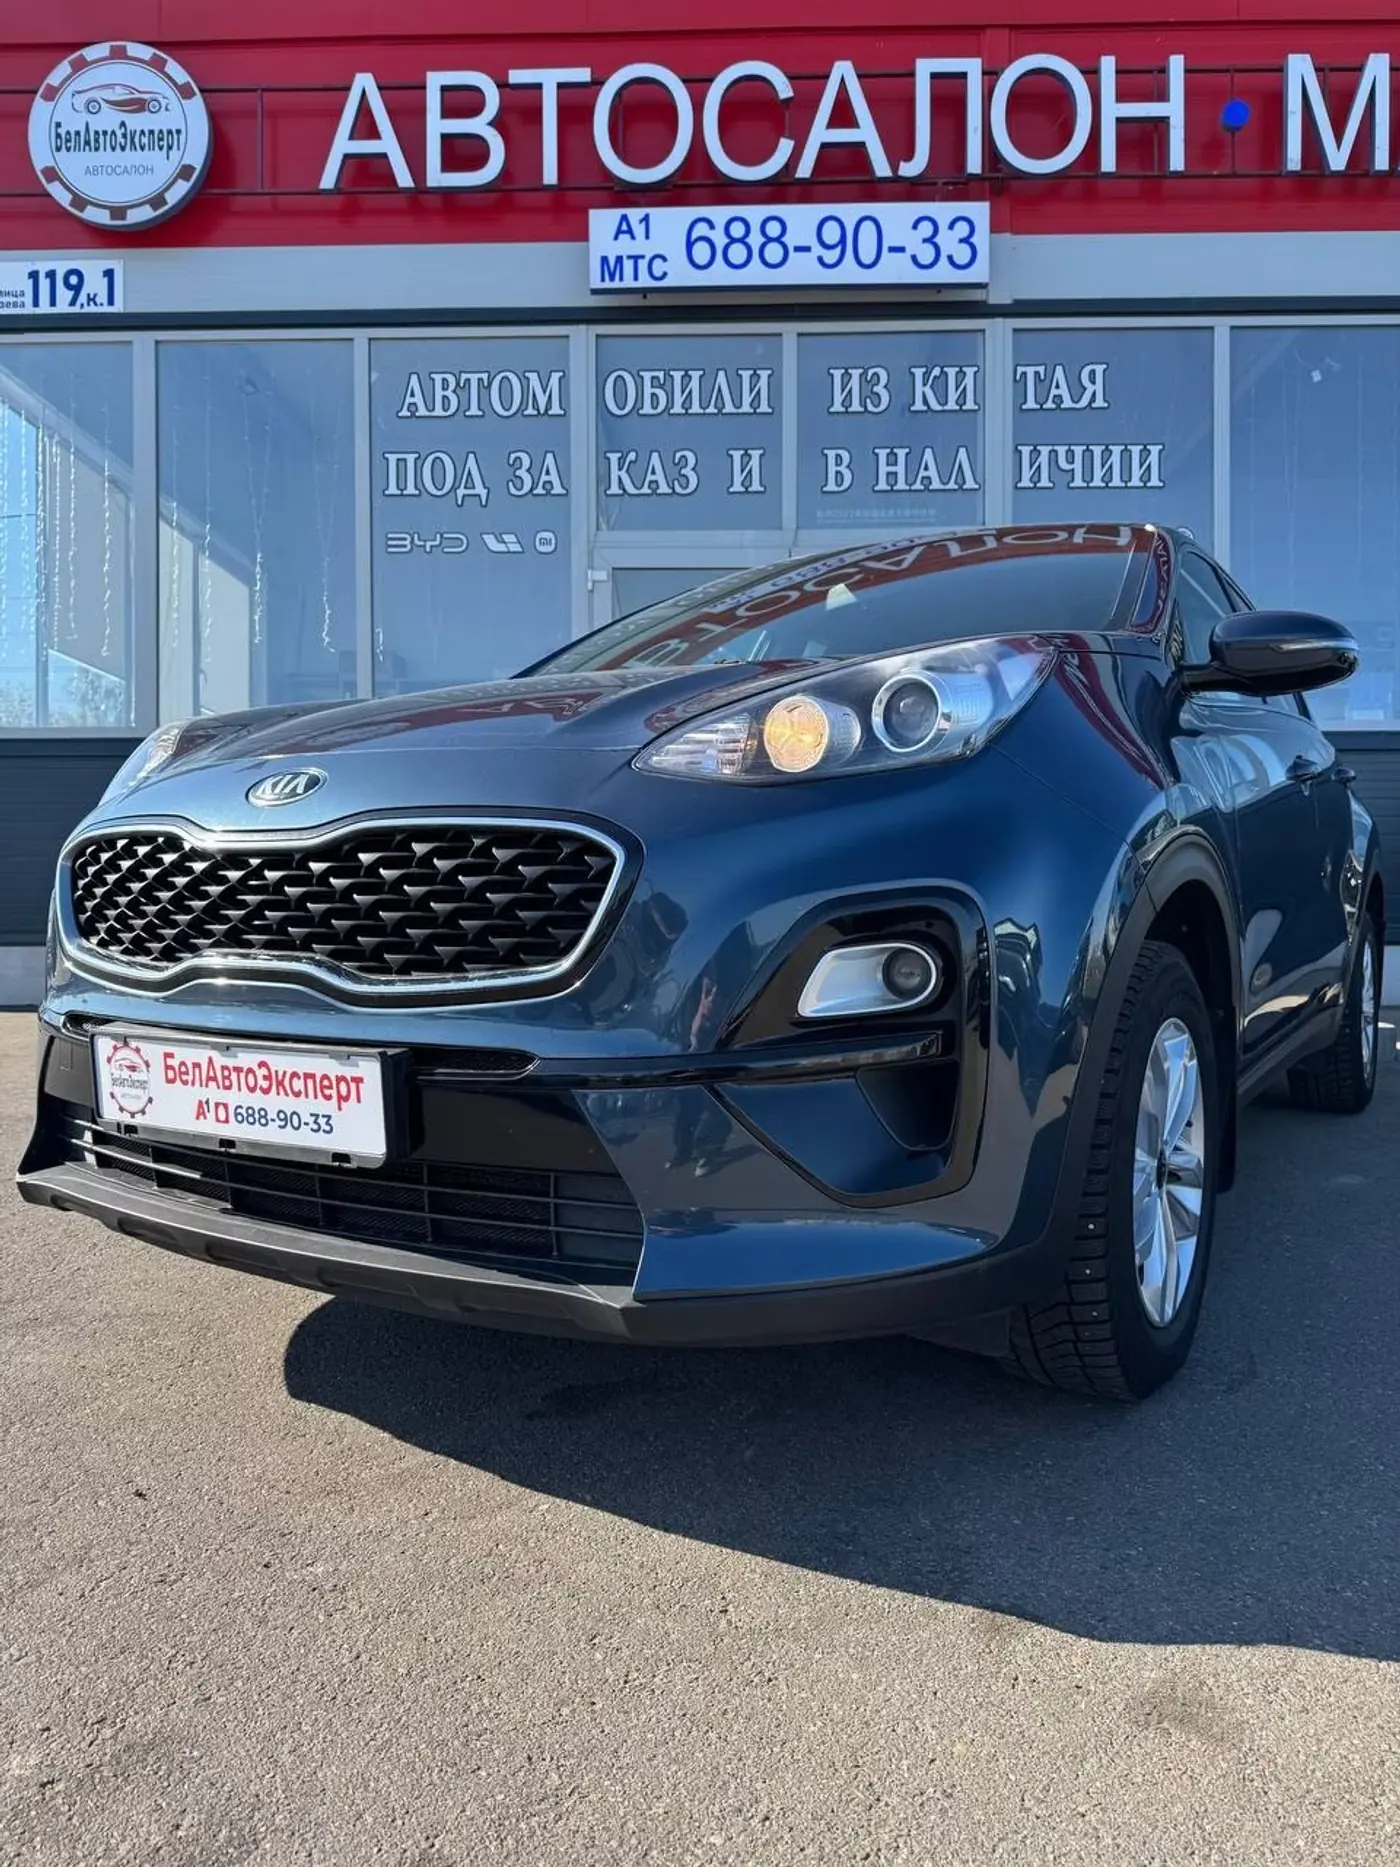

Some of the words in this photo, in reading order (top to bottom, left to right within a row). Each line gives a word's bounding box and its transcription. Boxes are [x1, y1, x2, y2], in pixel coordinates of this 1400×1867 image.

[54, 120, 182, 161] БелАвтоЭксперт
[319, 53, 1185, 189] АВТОСАЛОН
[84, 163, 154, 177] АВТОСАЛОН
[685, 214, 978, 271] 688-90-33
[828, 365, 890, 413] ИЗ
[383, 451, 489, 508] ПОД
[727, 448, 765, 494] И
[821, 447, 854, 492] В
[386, 531, 469, 554] BYD
[255, 773, 310, 797] KIA
[163, 1051, 365, 1111] БелАвтоЭксперт
[233, 1104, 334, 1135] 688-90-33
